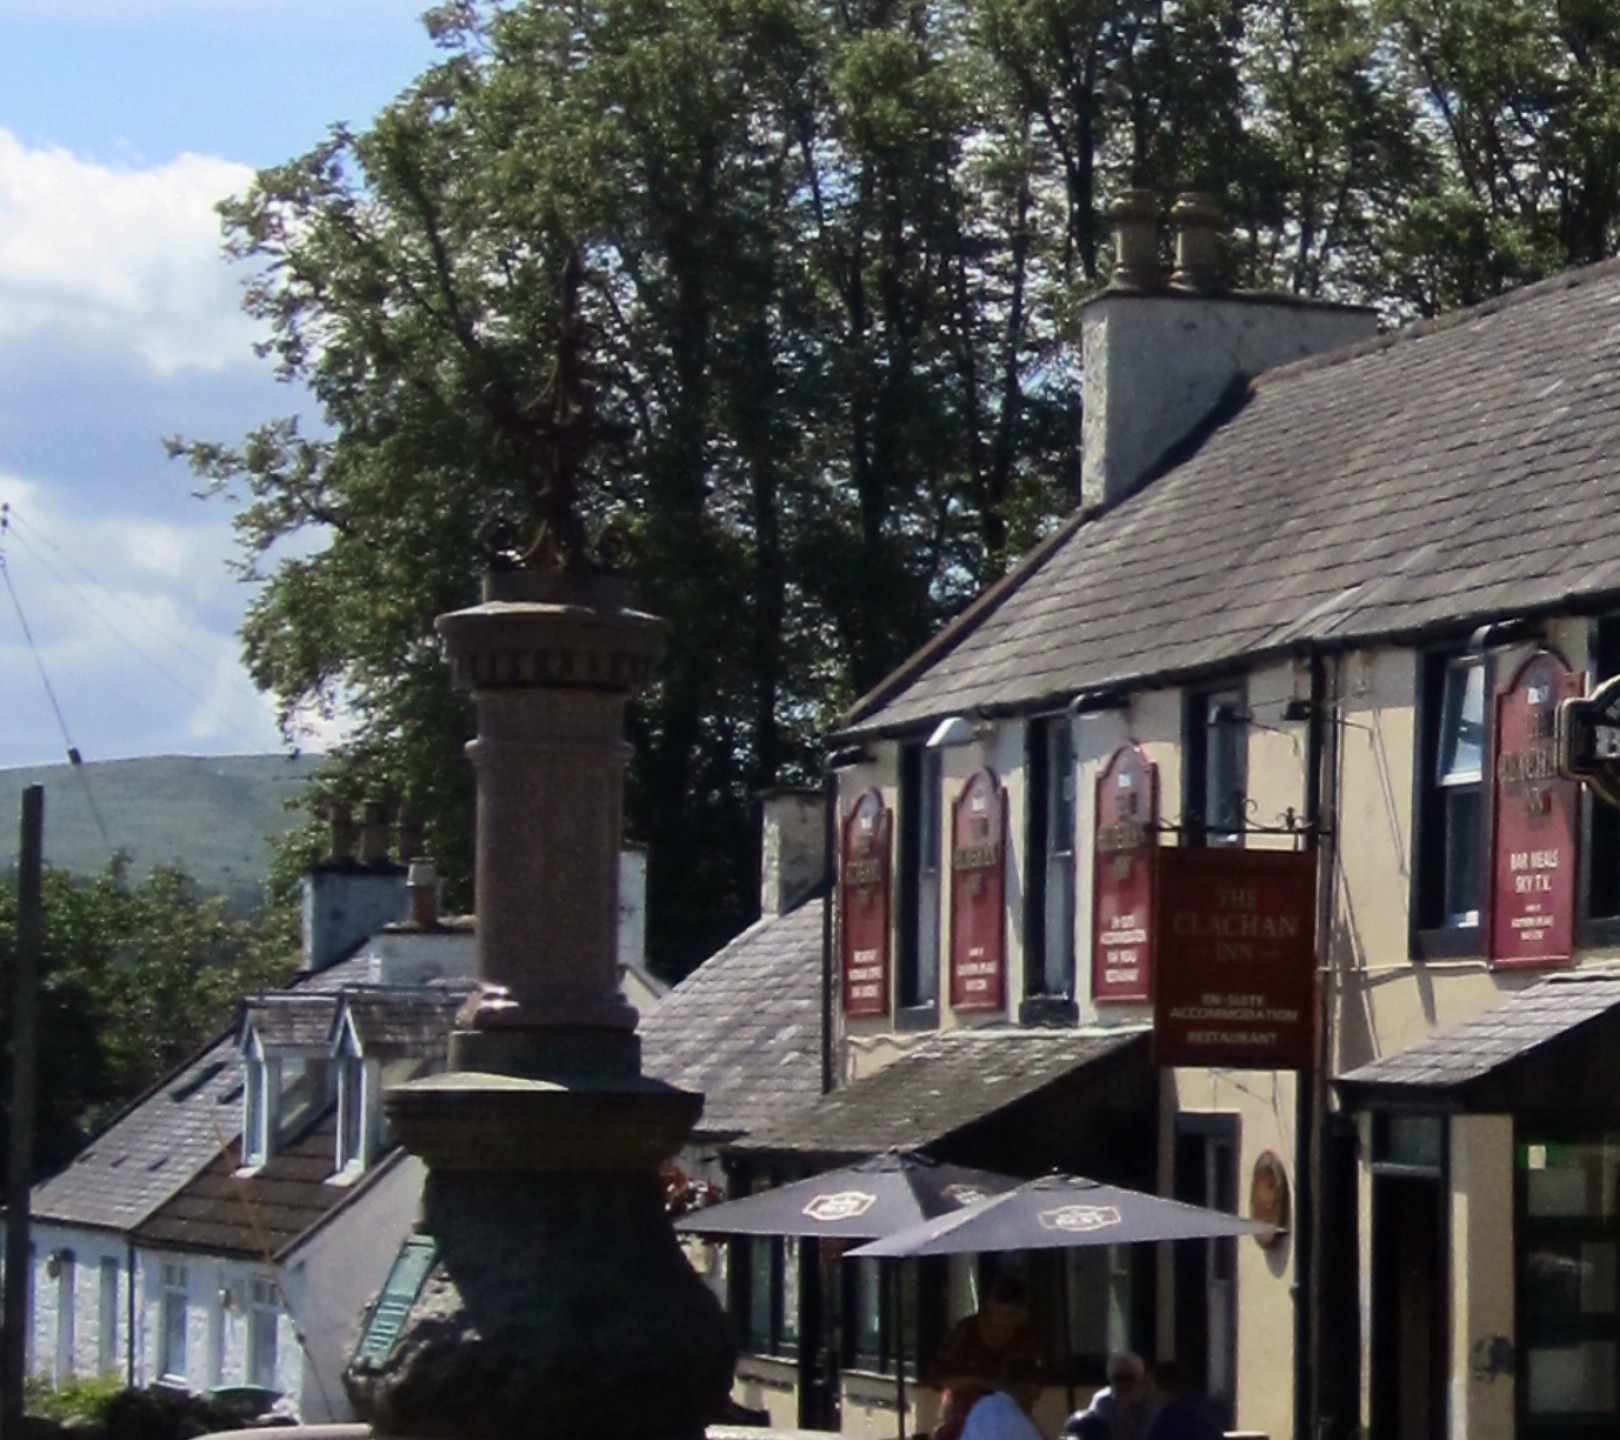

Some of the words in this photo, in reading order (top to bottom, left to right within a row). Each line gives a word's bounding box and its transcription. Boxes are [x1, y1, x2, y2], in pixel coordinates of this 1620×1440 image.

[1216, 888, 1258, 910] THE
[1173, 912, 1299, 938] CLACHAN
[1169, 1006, 1299, 1022] ACCOMMODATION
[1187, 1030, 1278, 1045] RESTAURANT
